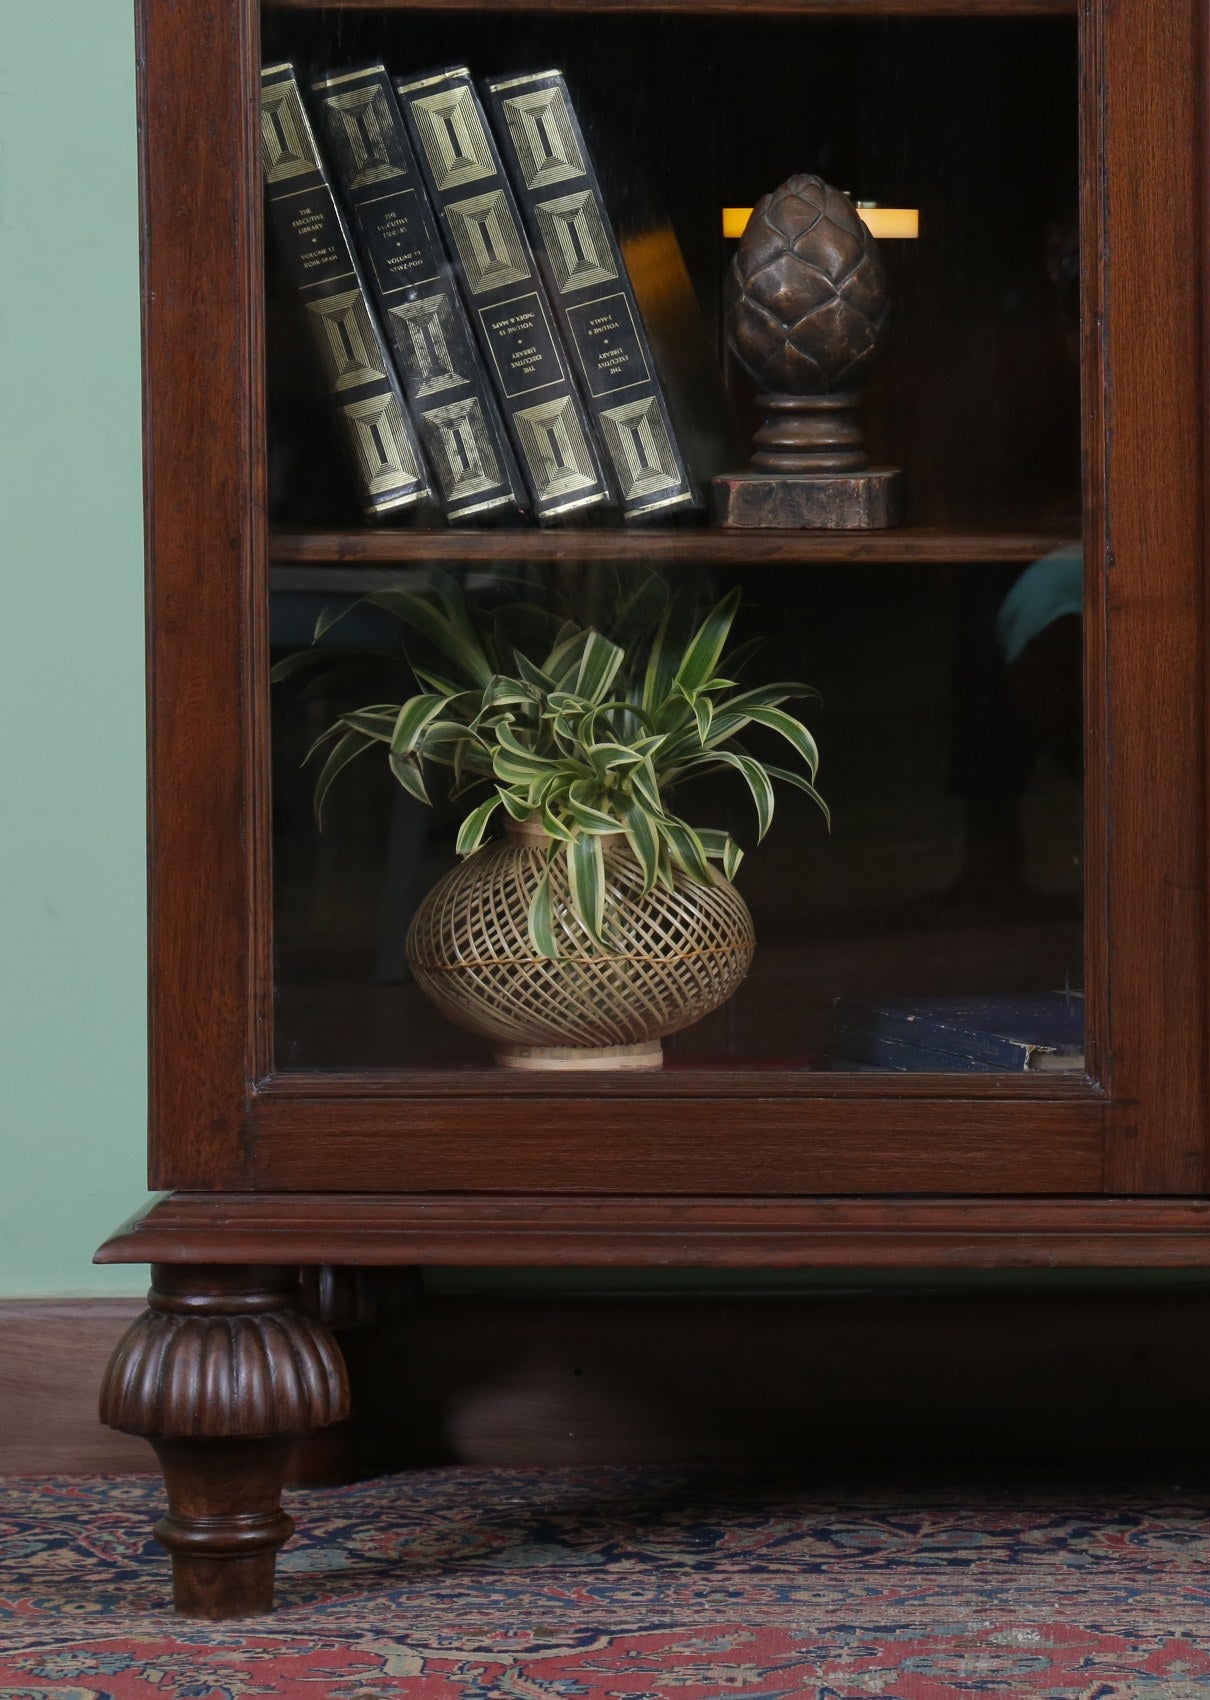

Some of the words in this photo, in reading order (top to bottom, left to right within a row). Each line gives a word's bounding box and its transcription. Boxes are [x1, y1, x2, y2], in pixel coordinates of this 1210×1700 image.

[300, 208, 312, 216] THE
[292, 213, 324, 227] EXECUTIVE
[298, 223, 323, 235] LIBRARY
[300, 248, 326, 259] VOLUME
[387, 252, 412, 265] VOLUME
[491, 319, 510, 330] MAPS
[507, 321, 534, 334] VOLUME
[593, 323, 619, 334] VOLUME
[511, 347, 537, 359] LIBRARY
[598, 347, 624, 360] LIBRARY
[510, 354, 543, 369] EXECUTIVE
[597, 354, 630, 370] EXECUTIVE
[523, 365, 536, 374] THE
[609, 366, 622, 375] THE
